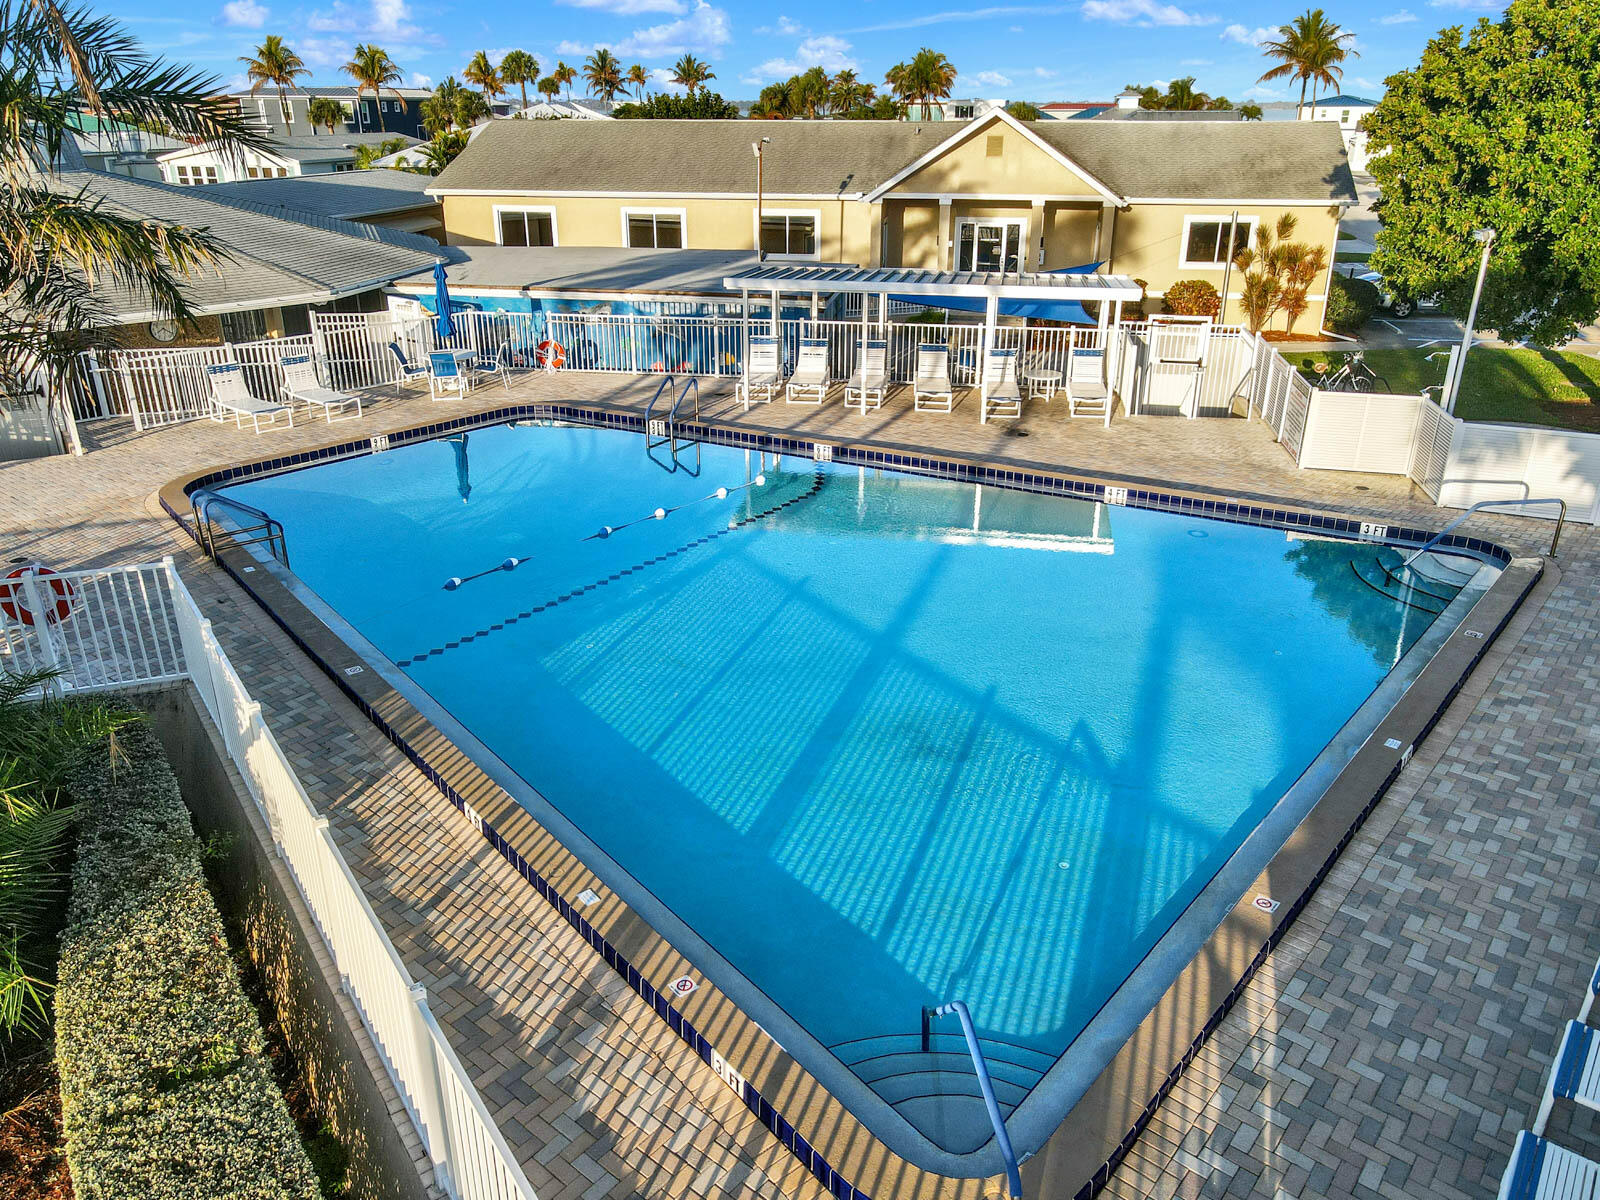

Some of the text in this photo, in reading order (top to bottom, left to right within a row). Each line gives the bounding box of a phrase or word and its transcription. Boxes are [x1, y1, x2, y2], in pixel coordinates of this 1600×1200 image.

[380, 436, 387, 448] FT
[1116, 489, 1126, 498] FT
[1363, 524, 1387, 537] 3 FT
[715, 1059, 741, 1093] 3 FT
